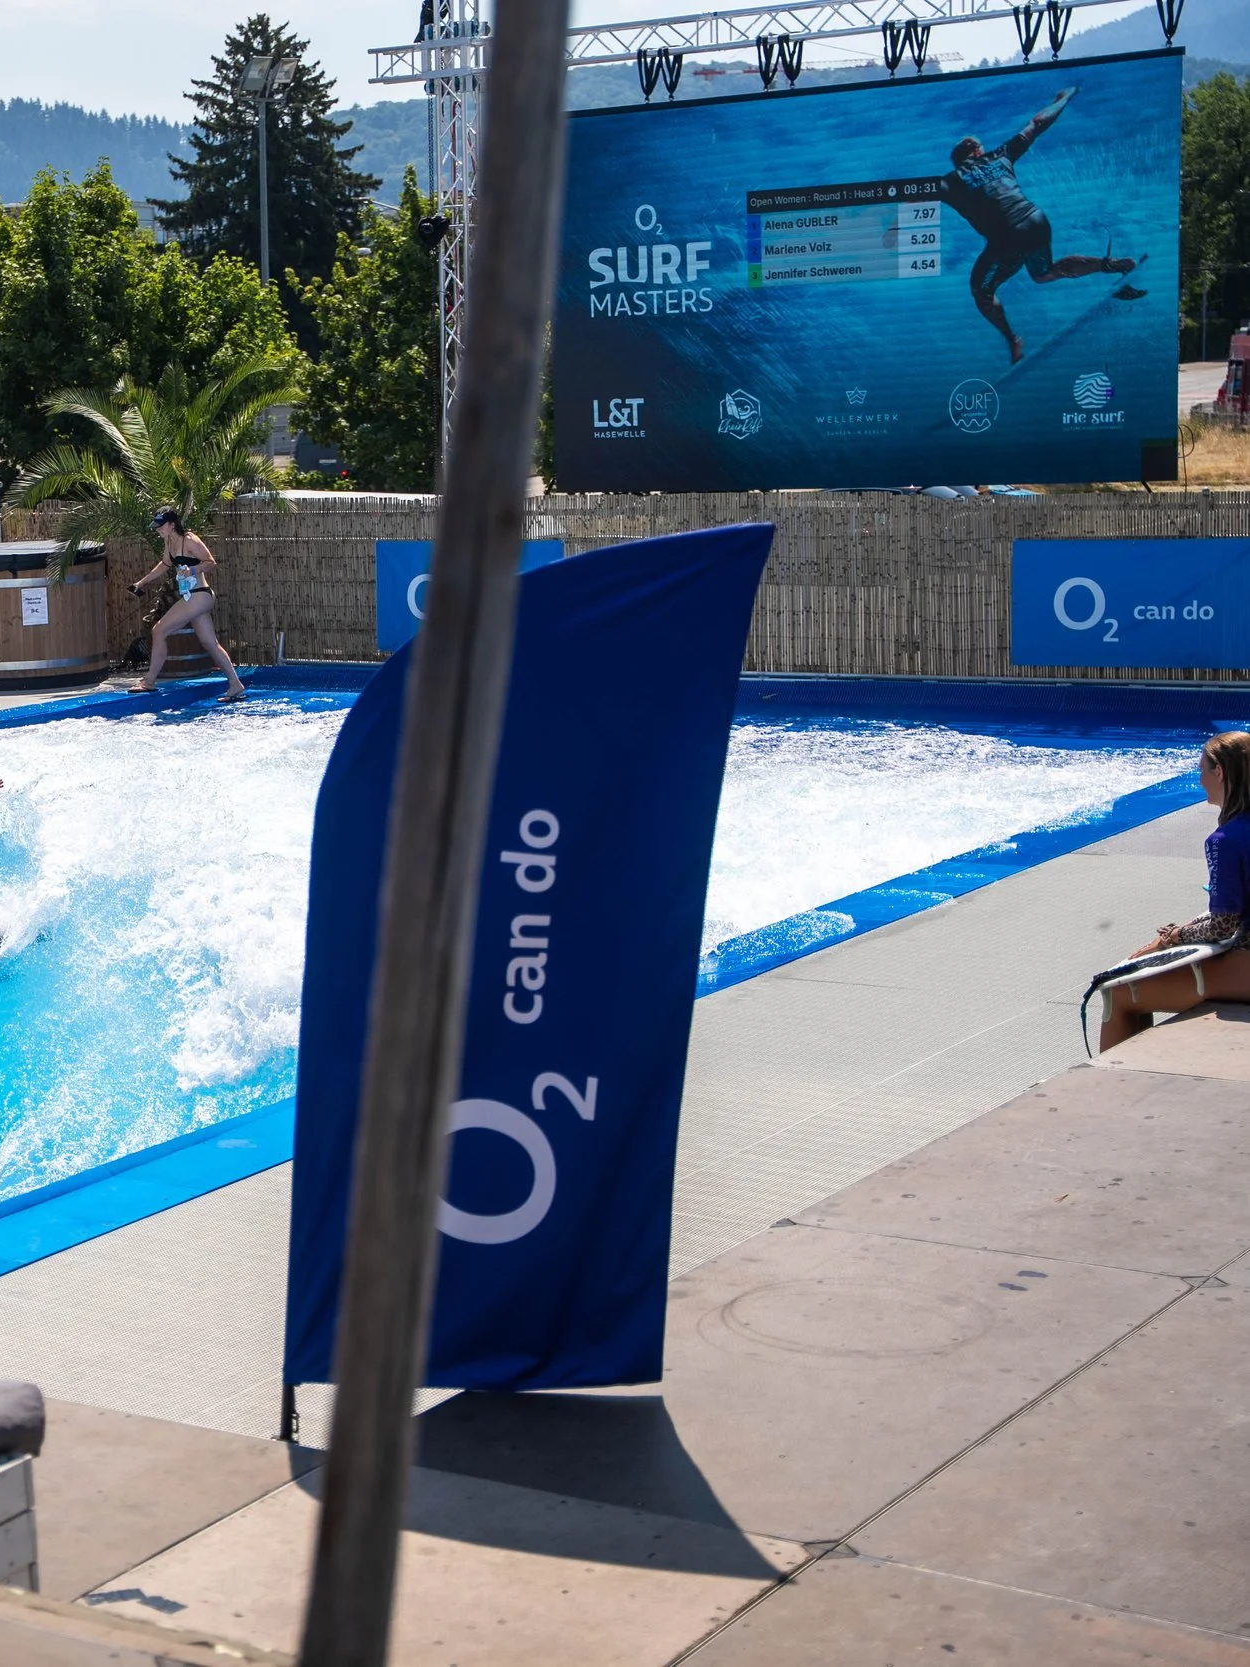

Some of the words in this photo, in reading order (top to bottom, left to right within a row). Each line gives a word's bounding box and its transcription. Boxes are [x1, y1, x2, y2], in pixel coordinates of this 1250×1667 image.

[750, 198, 772, 207] Open
[775, 196, 806, 204] Women
[813, 192, 840, 200] Round
[854, 189, 875, 198] Heat
[877, 188, 883, 197] 3
[904, 183, 937, 194] 09:31
[635, 204, 663, 235] O2
[913, 208, 936, 219] 7.97
[764, 220, 794, 230] Alena
[796, 216, 838, 228] GUBLER
[910, 234, 936, 245] 5.20
[764, 244, 807, 256] Marlene
[809, 242, 832, 252] Volz
[588, 241, 712, 289] SURF
[764, 268, 808, 280] Jennifer
[810, 265, 862, 277] Schweren
[910, 260, 936, 271] 4.54
[590, 287, 713, 318] MASTERS
[955, 392, 993, 410] SURF
[593, 398, 645, 428] L&T
[1062, 412, 1087, 424] irie
[594, 430, 646, 438] HASEWELLE
[1053, 576, 1119, 642] O2
[1133, 604, 1176, 621] can
[1182, 600, 1215, 621] do
[500, 808, 560, 894] do
[503, 913, 552, 1025] can
[435, 1071, 599, 1245] O2
